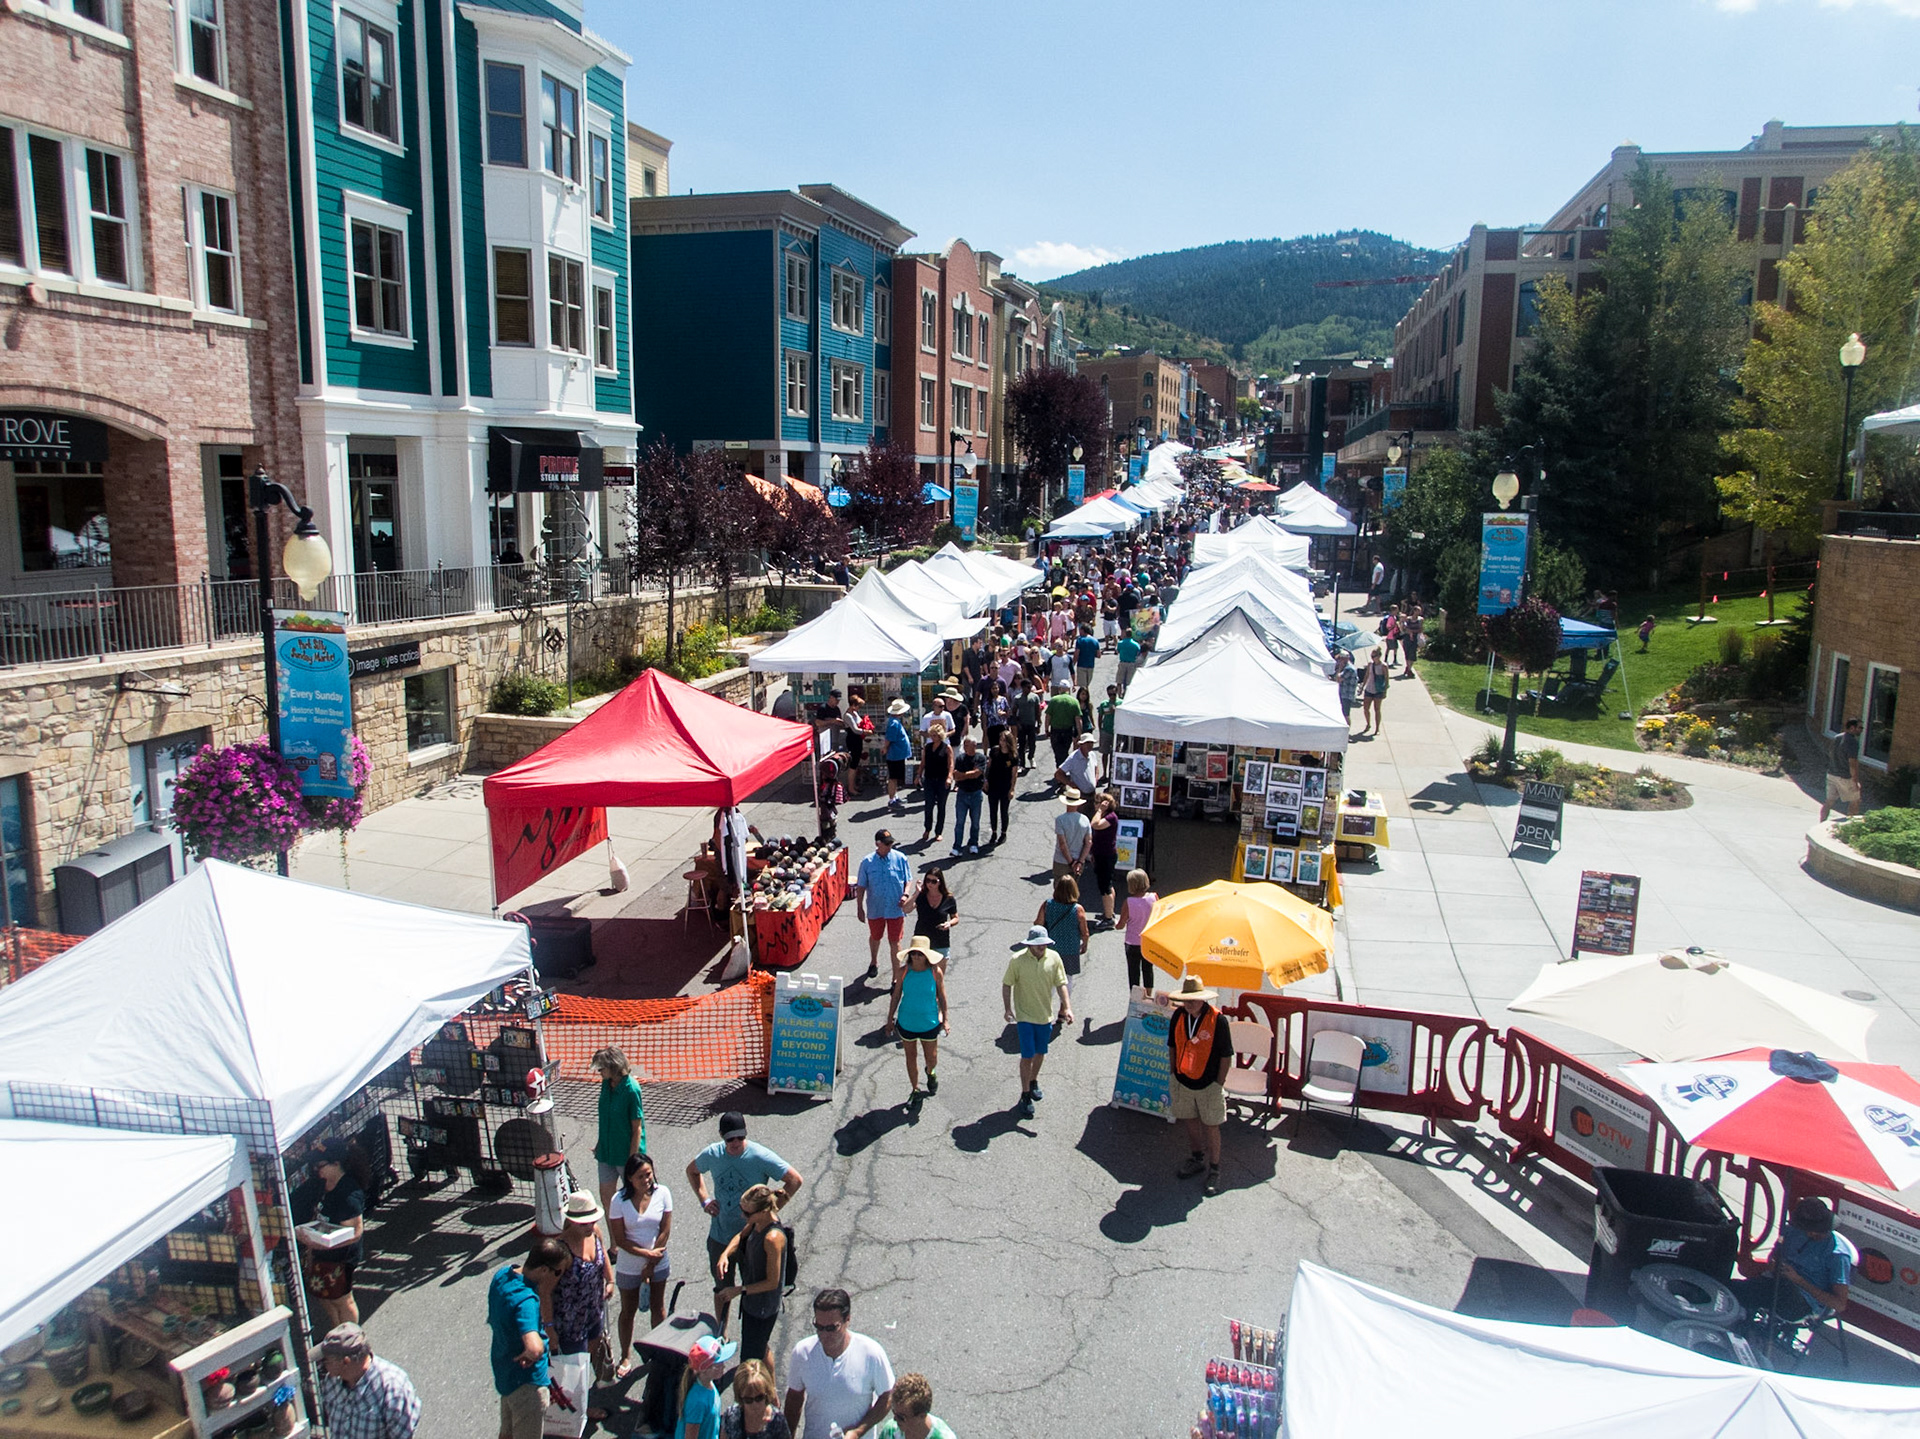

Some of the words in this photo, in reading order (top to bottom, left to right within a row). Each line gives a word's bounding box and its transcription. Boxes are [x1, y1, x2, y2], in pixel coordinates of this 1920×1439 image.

[5, 449, 71, 460] allery
[769, 454, 781, 464] 38
[540, 455, 579, 474] PRIME
[541, 473, 559, 482] STEAK
[561, 473, 579, 482] HOUSE
[356, 658, 380, 671] image
[381, 654, 398, 668] eyes
[290, 688, 313, 700] Every
[314, 690, 343, 703] Sunday
[291, 706, 313, 715] Historic
[314, 707, 328, 715] Main
[329, 708, 344, 717] Street
[313, 716, 344, 726] September
[1525, 782, 1562, 800] MAIN
[1516, 823, 1555, 841] OPEN
[777, 1017, 815, 1028] PLEASE
[818, 1021, 834, 1029] NO
[780, 1029, 829, 1040] ALCOHOL
[1130, 1033, 1164, 1047] PLEASE
[782, 1040, 826, 1052] BEYOND
[1129, 1043, 1169, 1059] ALCOHO
[776, 1049, 798, 1059] THIS
[1123, 1063, 1144, 1075] THIS
[1577, 1078, 1609, 1102] BILLBOARD
[1597, 1122, 1634, 1150] OTW
[557, 1166, 568, 1207] TEXA
[1845, 1209, 1863, 1222] THE
[1865, 1217, 1918, 1244] BILLBOARD
